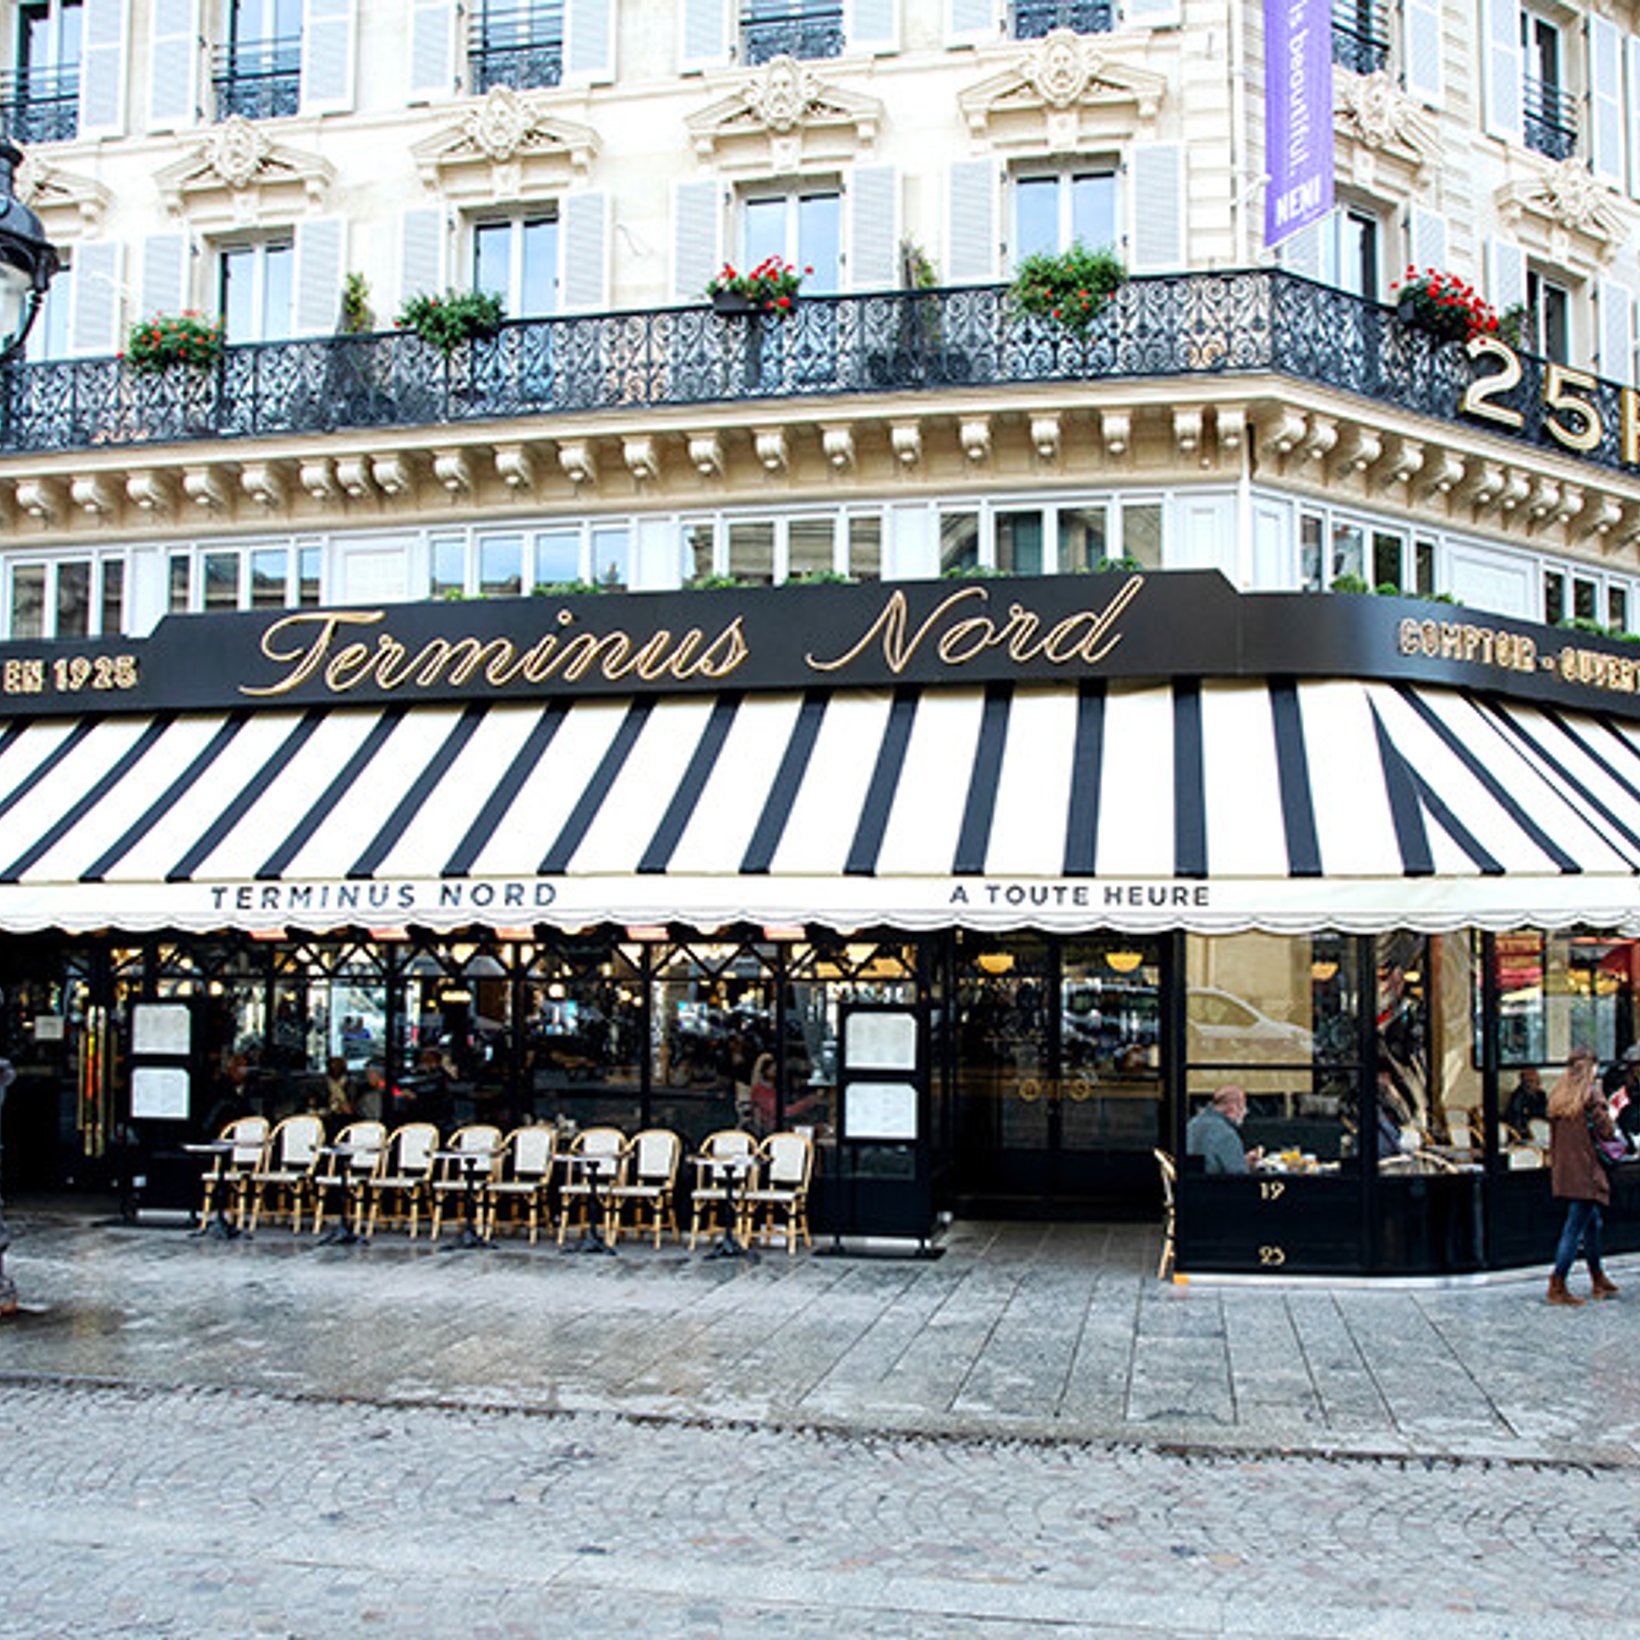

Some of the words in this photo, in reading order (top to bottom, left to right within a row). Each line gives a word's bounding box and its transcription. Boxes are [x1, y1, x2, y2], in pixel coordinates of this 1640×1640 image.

[1289, 28, 1310, 177] beautiful.
[1275, 174, 1320, 228] NENI
[237, 609, 749, 696] Terminus
[804, 574, 1144, 673] Nord
[1399, 617, 1536, 673] COMPTOIR
[4, 659, 44, 694] EN
[53, 655, 138, 692] 1925
[211, 885, 416, 910] TERMINUS
[439, 883, 557, 907] NORD
[949, 885, 969, 904] A
[985, 885, 1089, 906] TOUTE
[1103, 885, 1210, 907] HEURE
[1260, 1181, 1286, 1200] 19
